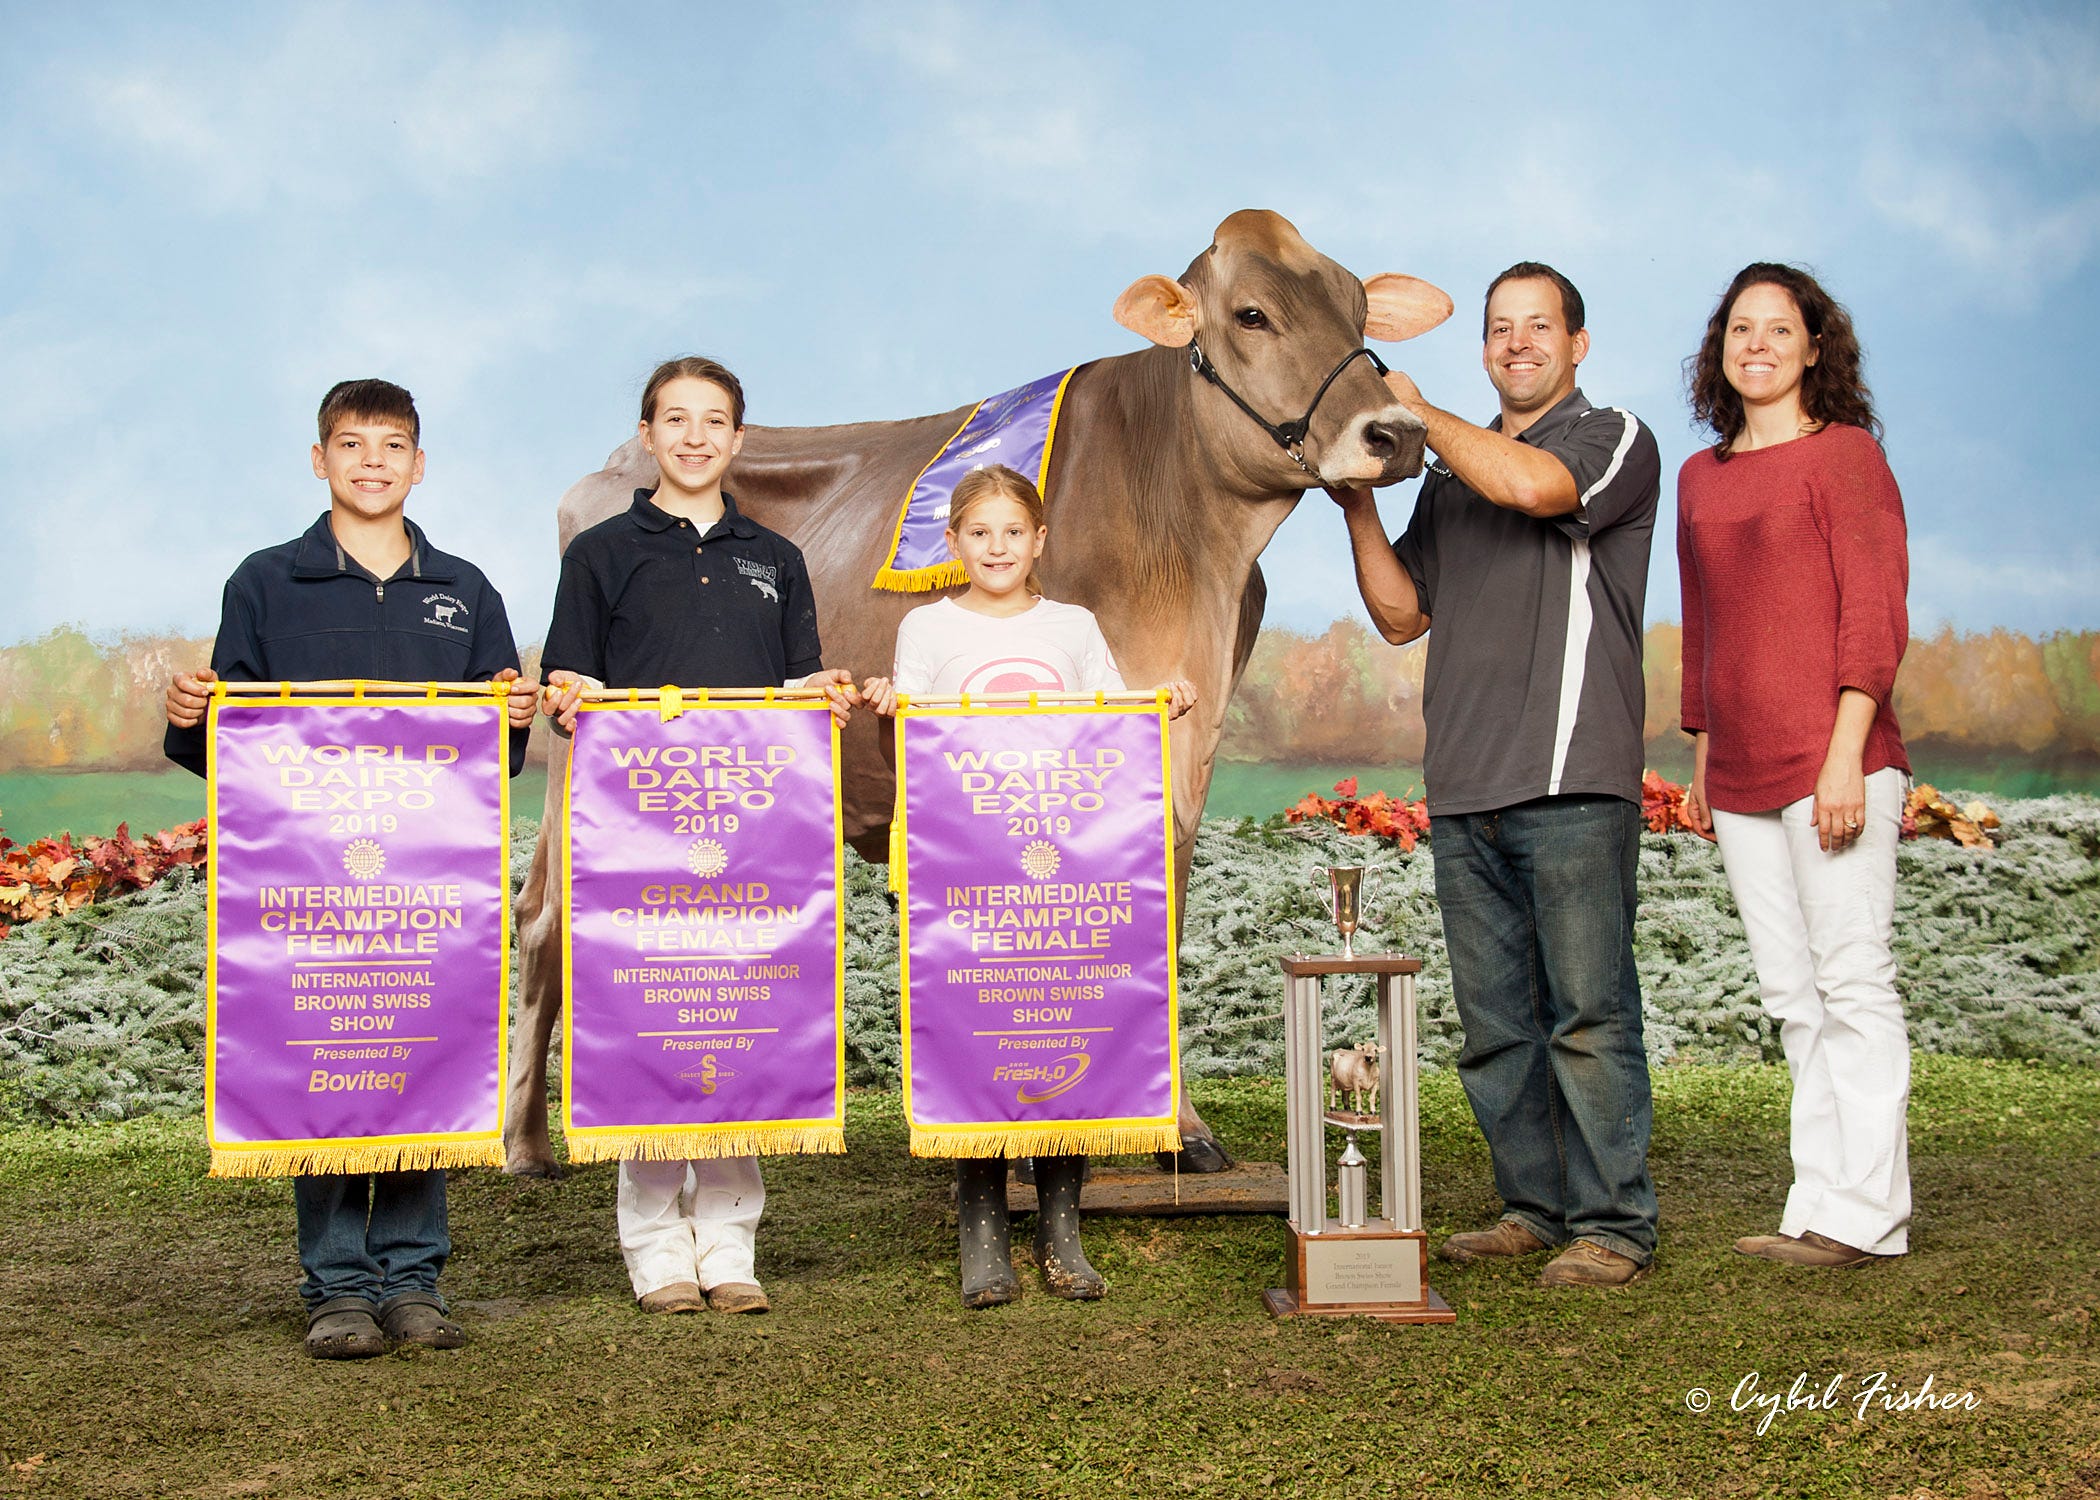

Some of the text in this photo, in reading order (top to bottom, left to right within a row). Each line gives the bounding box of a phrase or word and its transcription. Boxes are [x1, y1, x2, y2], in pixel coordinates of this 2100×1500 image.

[439, 594, 456, 603] Dairy
[261, 744, 461, 766] WORLD
[609, 744, 798, 768] WORLD
[944, 748, 1126, 771] WORLD
[279, 766, 445, 788] DAIRY
[627, 767, 785, 790] DAIRY
[961, 769, 1113, 793] DAIRY
[290, 789, 436, 812] EXPO
[638, 790, 776, 813] EXPO
[972, 792, 1105, 815] EXPO
[328, 814, 398, 834] 2019
[673, 814, 739, 834] 2019
[1007, 816, 1071, 836] 2019
[259, 884, 462, 909] INTERMEDIATE
[640, 882, 770, 905] GRAND
[946, 881, 1132, 907] INTERMEDIATE
[259, 908, 462, 932] CHAMPION
[611, 903, 799, 928] CHAMPION
[946, 904, 1133, 930] CHAMPION
[286, 932, 439, 956] FEMALE
[635, 928, 778, 951] FEMALE
[971, 928, 1111, 953] FEMALE
[291, 971, 436, 989] INTERNATIONAL
[613, 964, 800, 985] INTERNATIONAL JUNIOR
[947, 963, 1132, 985] INTERNATIONAL JUNIOR
[294, 993, 431, 1011] BROWN SWISS
[644, 986, 771, 1003] BROWN SWISS
[978, 985, 1104, 1003] BROWN SWISS
[329, 1015, 395, 1032] SHOW
[677, 1007, 738, 1023] SHOW
[1012, 1006, 1073, 1023] SHOW
[312, 1044, 411, 1060] Presented By
[662, 1036, 755, 1052] Presented By
[997, 1035, 1089, 1052] Presented By
[307, 1069, 407, 1096] Boviteq
